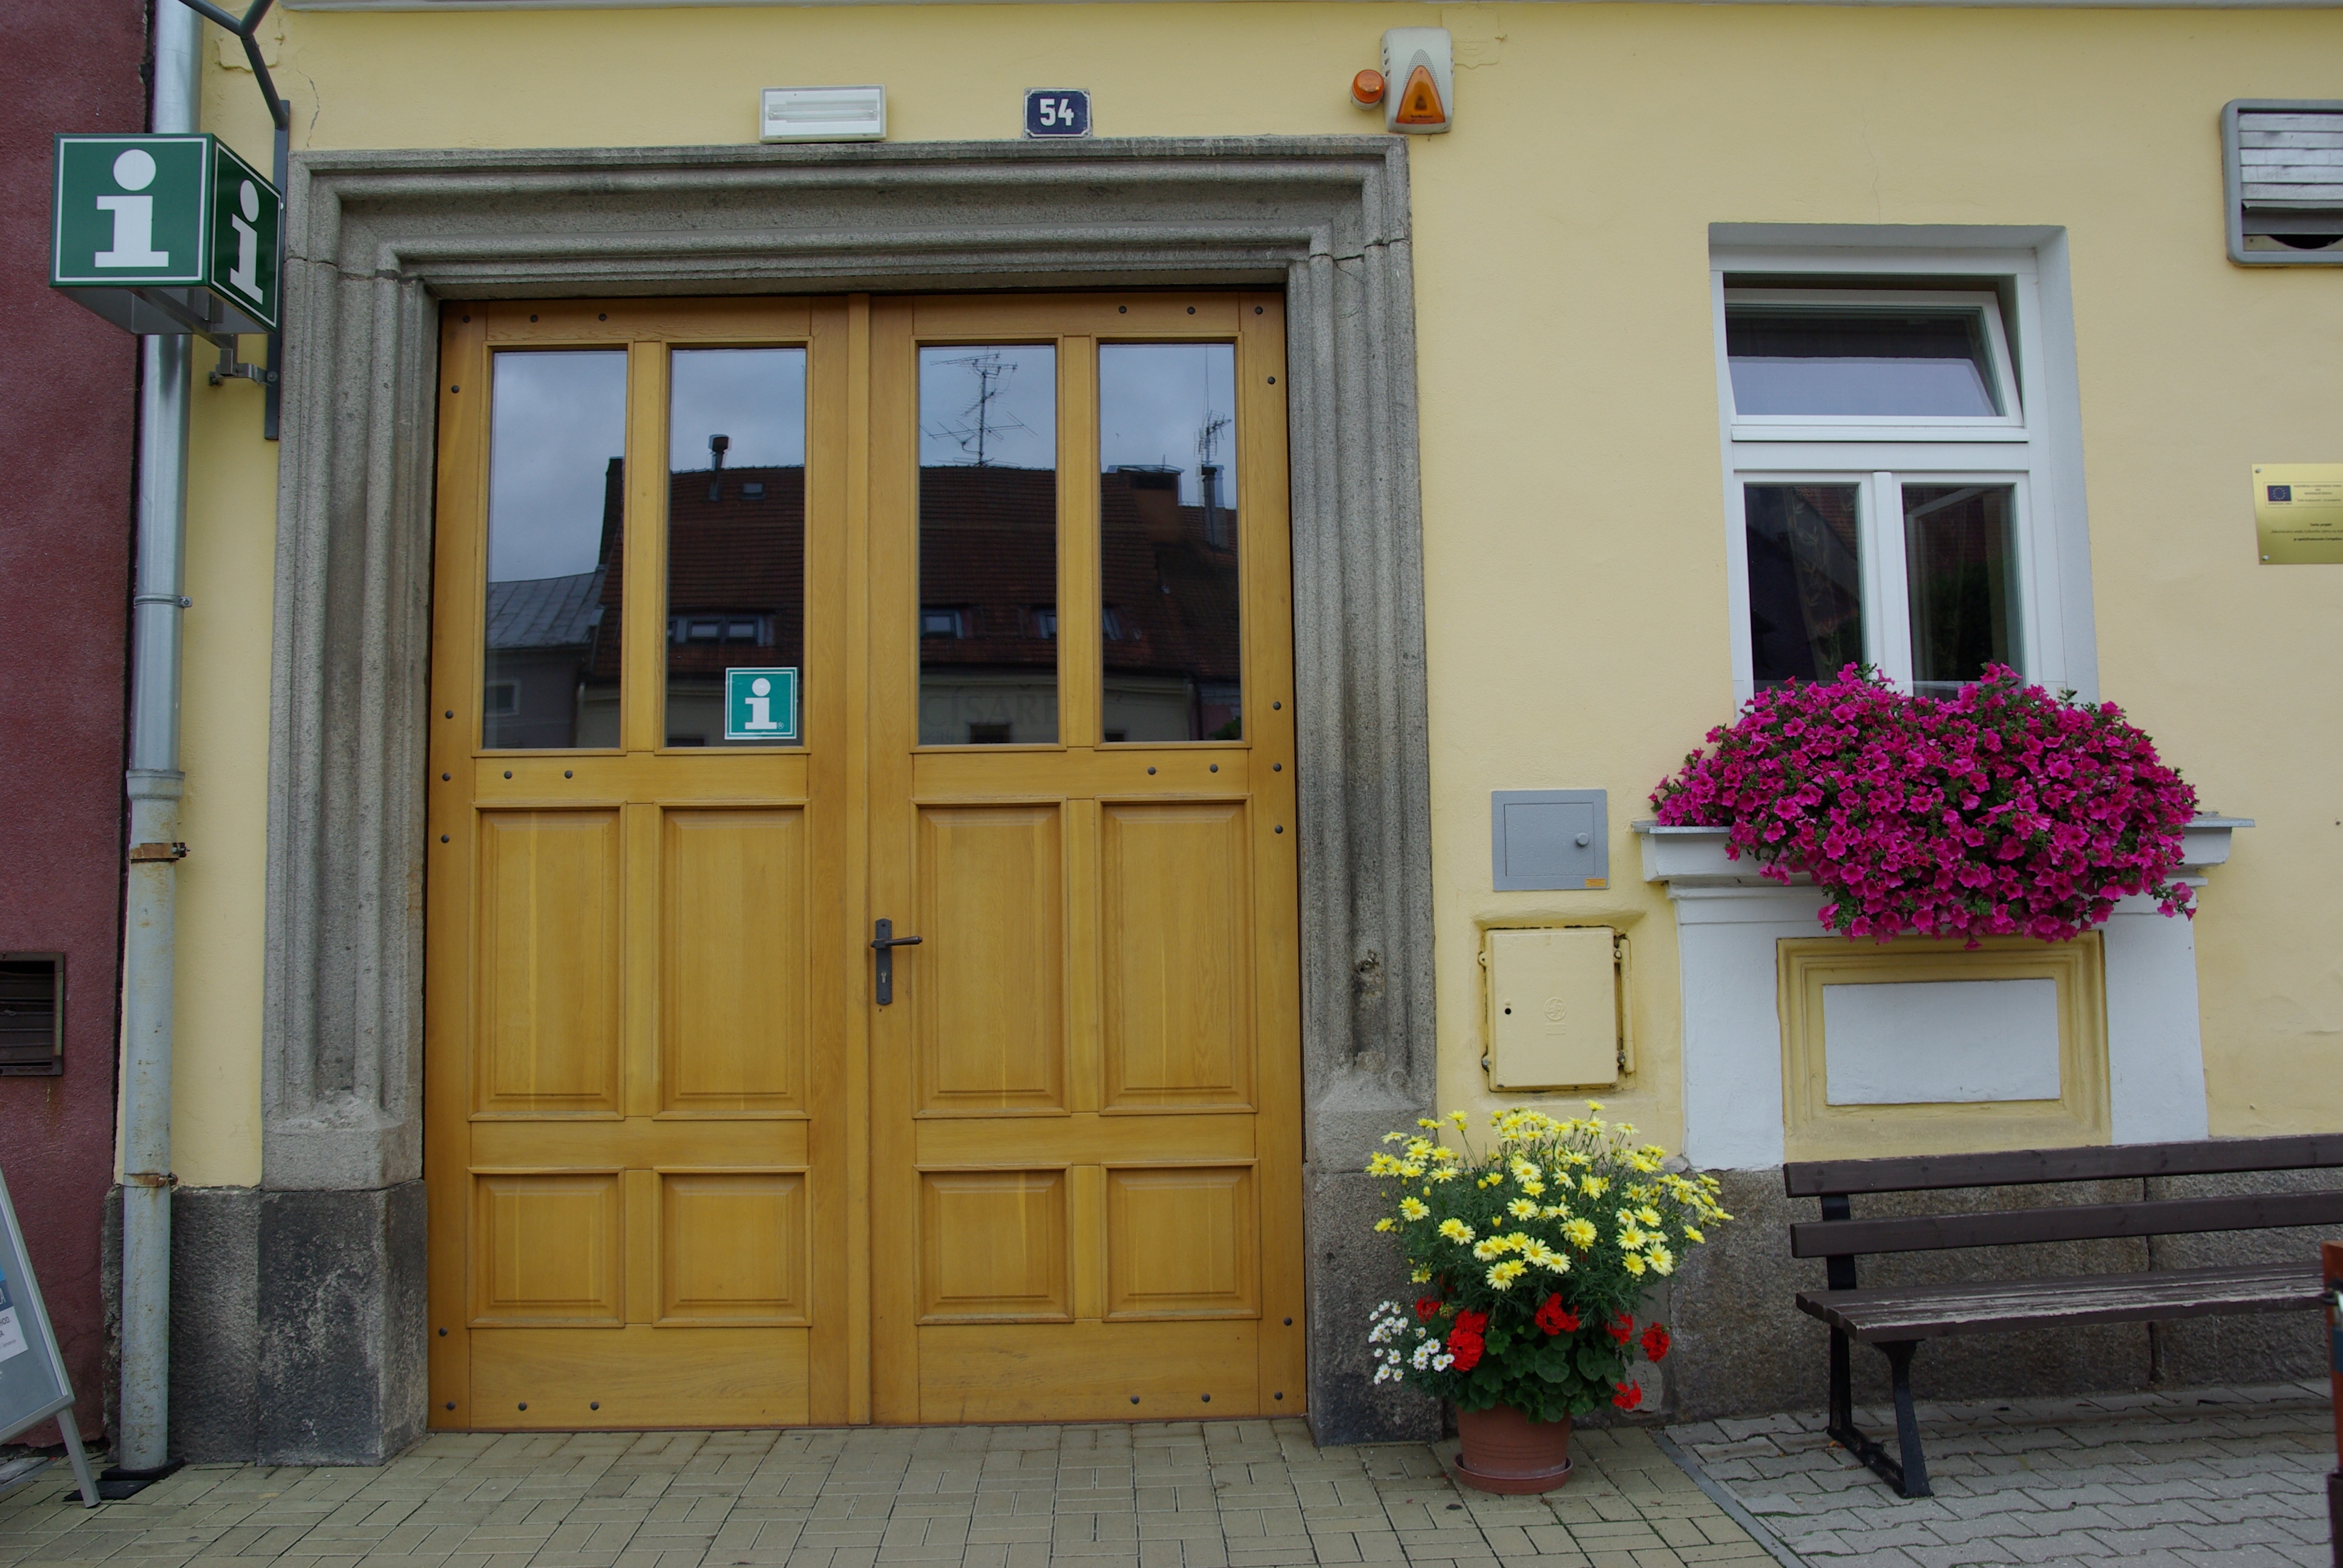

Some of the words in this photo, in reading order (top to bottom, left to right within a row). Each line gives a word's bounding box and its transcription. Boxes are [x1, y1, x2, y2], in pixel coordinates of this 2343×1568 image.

[1040, 98, 1075, 126] 54
[94, 149, 169, 267] i
[230, 180, 263, 305] i
